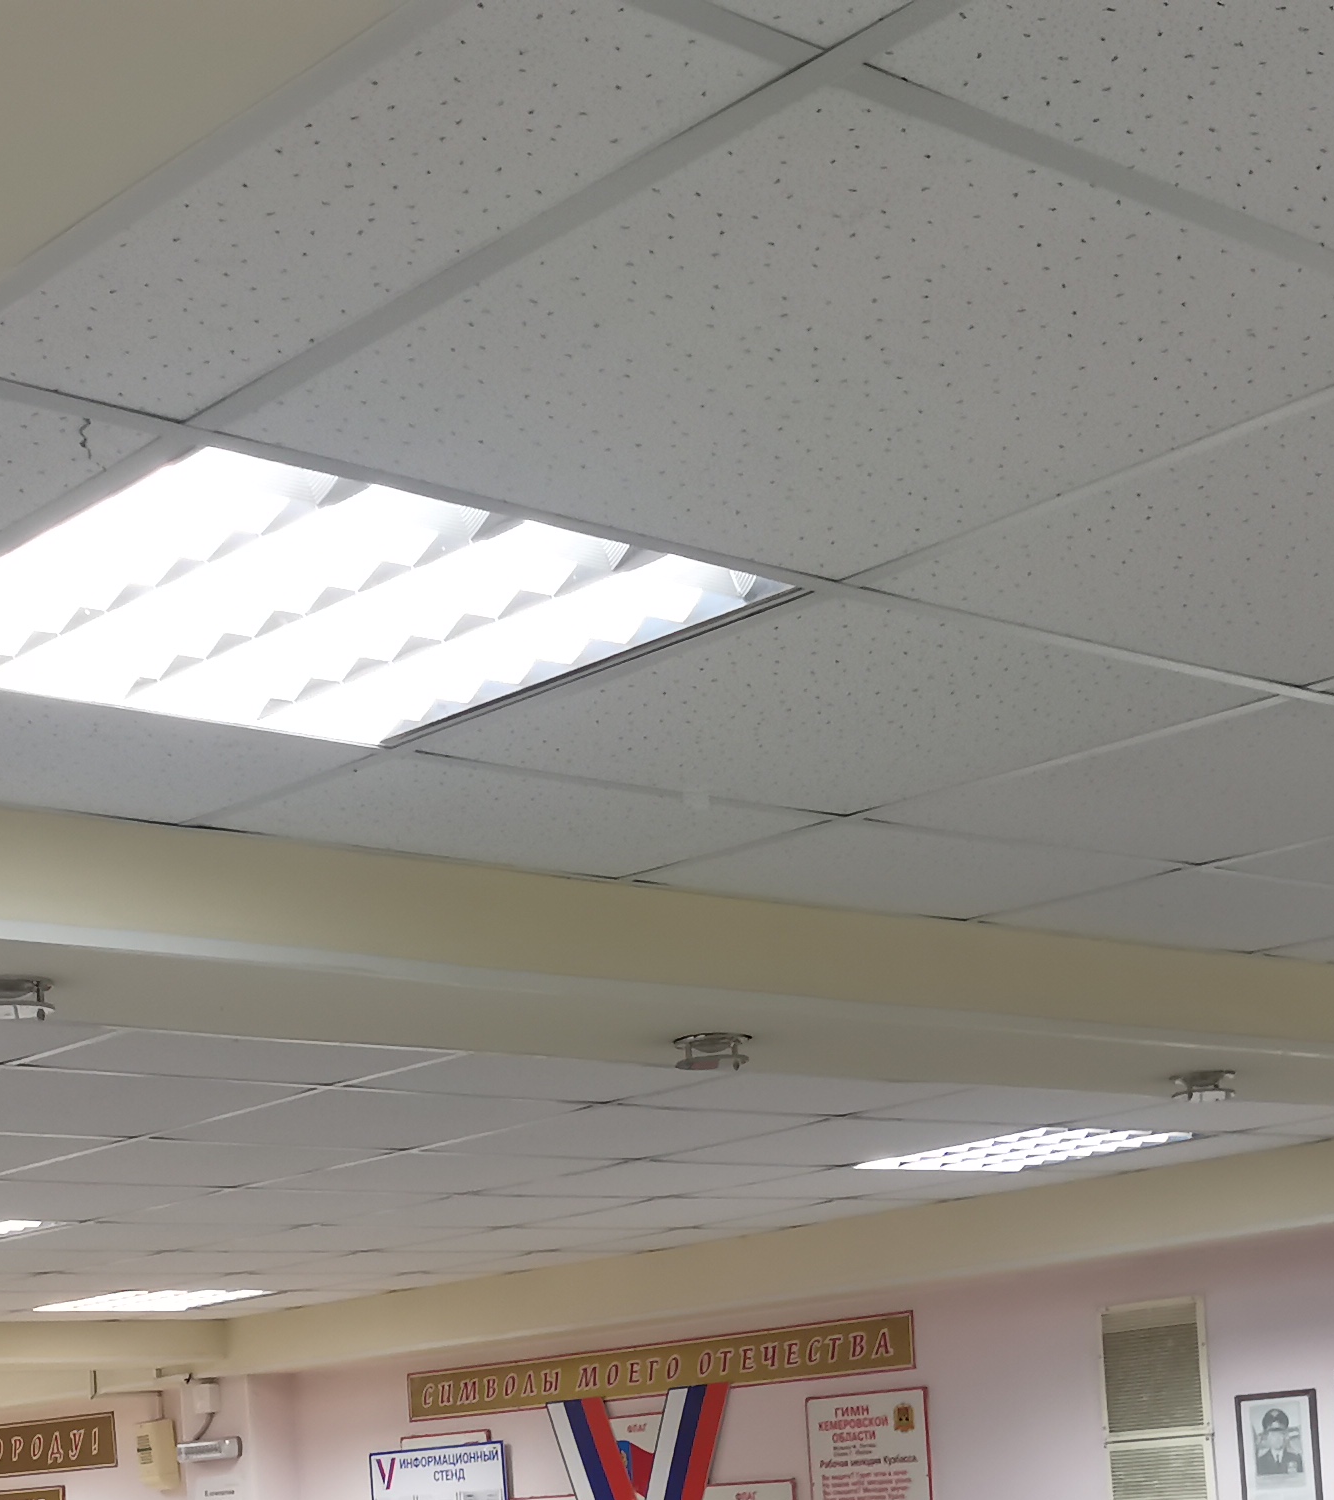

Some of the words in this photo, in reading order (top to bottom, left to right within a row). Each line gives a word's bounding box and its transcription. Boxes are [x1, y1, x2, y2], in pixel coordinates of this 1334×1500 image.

[421, 1369, 561, 1409] СИМВОЛЫ
[576, 1356, 680, 1391] МОЕГО
[698, 1328, 894, 1377] ОТЕЧЕСТВА
[834, 1405, 870, 1418] ГИМН
[627, 1423, 647, 1433] ФЛАГ
[818, 1415, 889, 1431] КЕМЕРОВСКОЙ
[832, 1430, 876, 1443] ОБЛАСТИ
[399, 1447, 499, 1469] ИНФОРМАЦИОННЫЙ
[433, 1468, 466, 1482] СТЕНД
[735, 1491, 757, 1500] ФЛАГ
